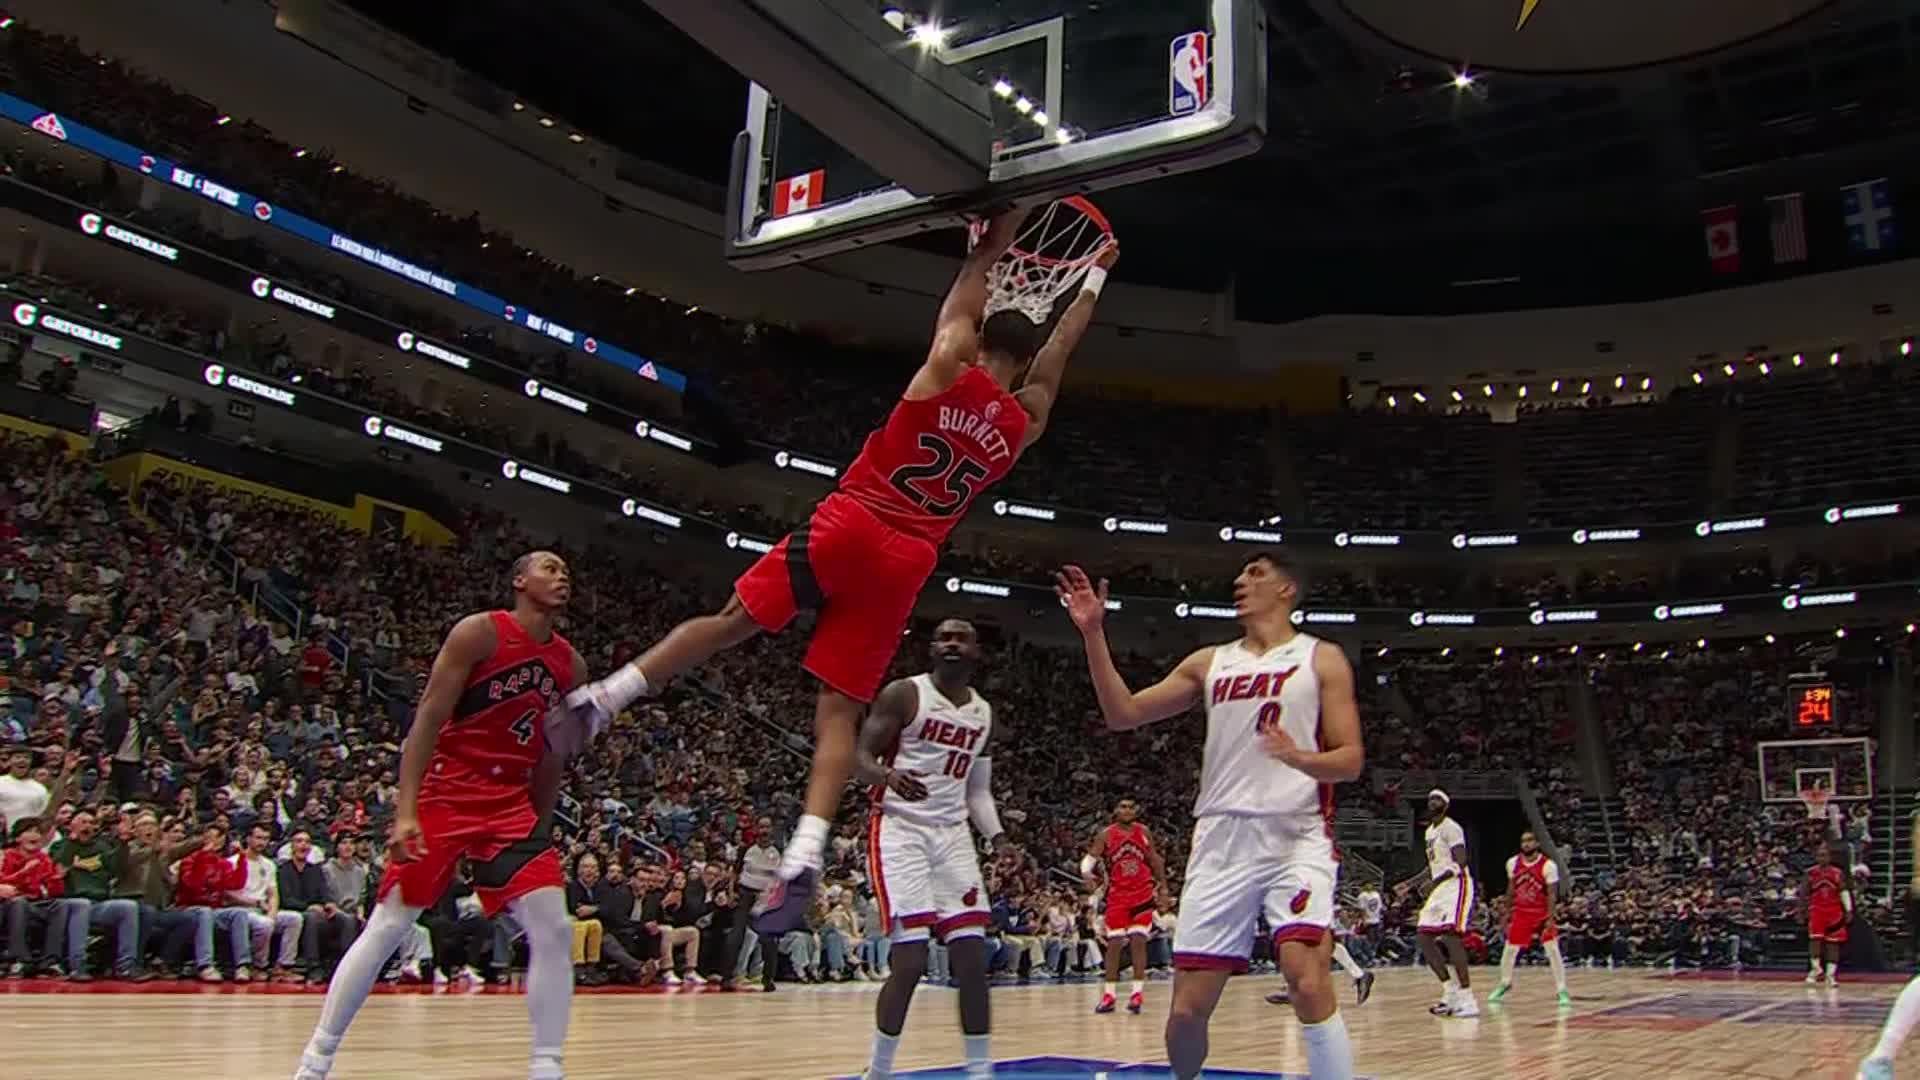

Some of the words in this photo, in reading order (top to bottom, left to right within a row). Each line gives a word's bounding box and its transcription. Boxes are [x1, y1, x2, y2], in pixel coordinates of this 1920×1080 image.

[41, 314, 123, 350] GATORADE
[939, 405, 1010, 462] BURNETT
[889, 433, 990, 516] 25
[488, 666, 561, 707] RAPTOR
[1212, 664, 1299, 707] HEAT
[508, 708, 540, 745] 4
[1798, 701, 1831, 724] 24
[919, 718, 985, 751] HEAT
[943, 750, 972, 780] 10
